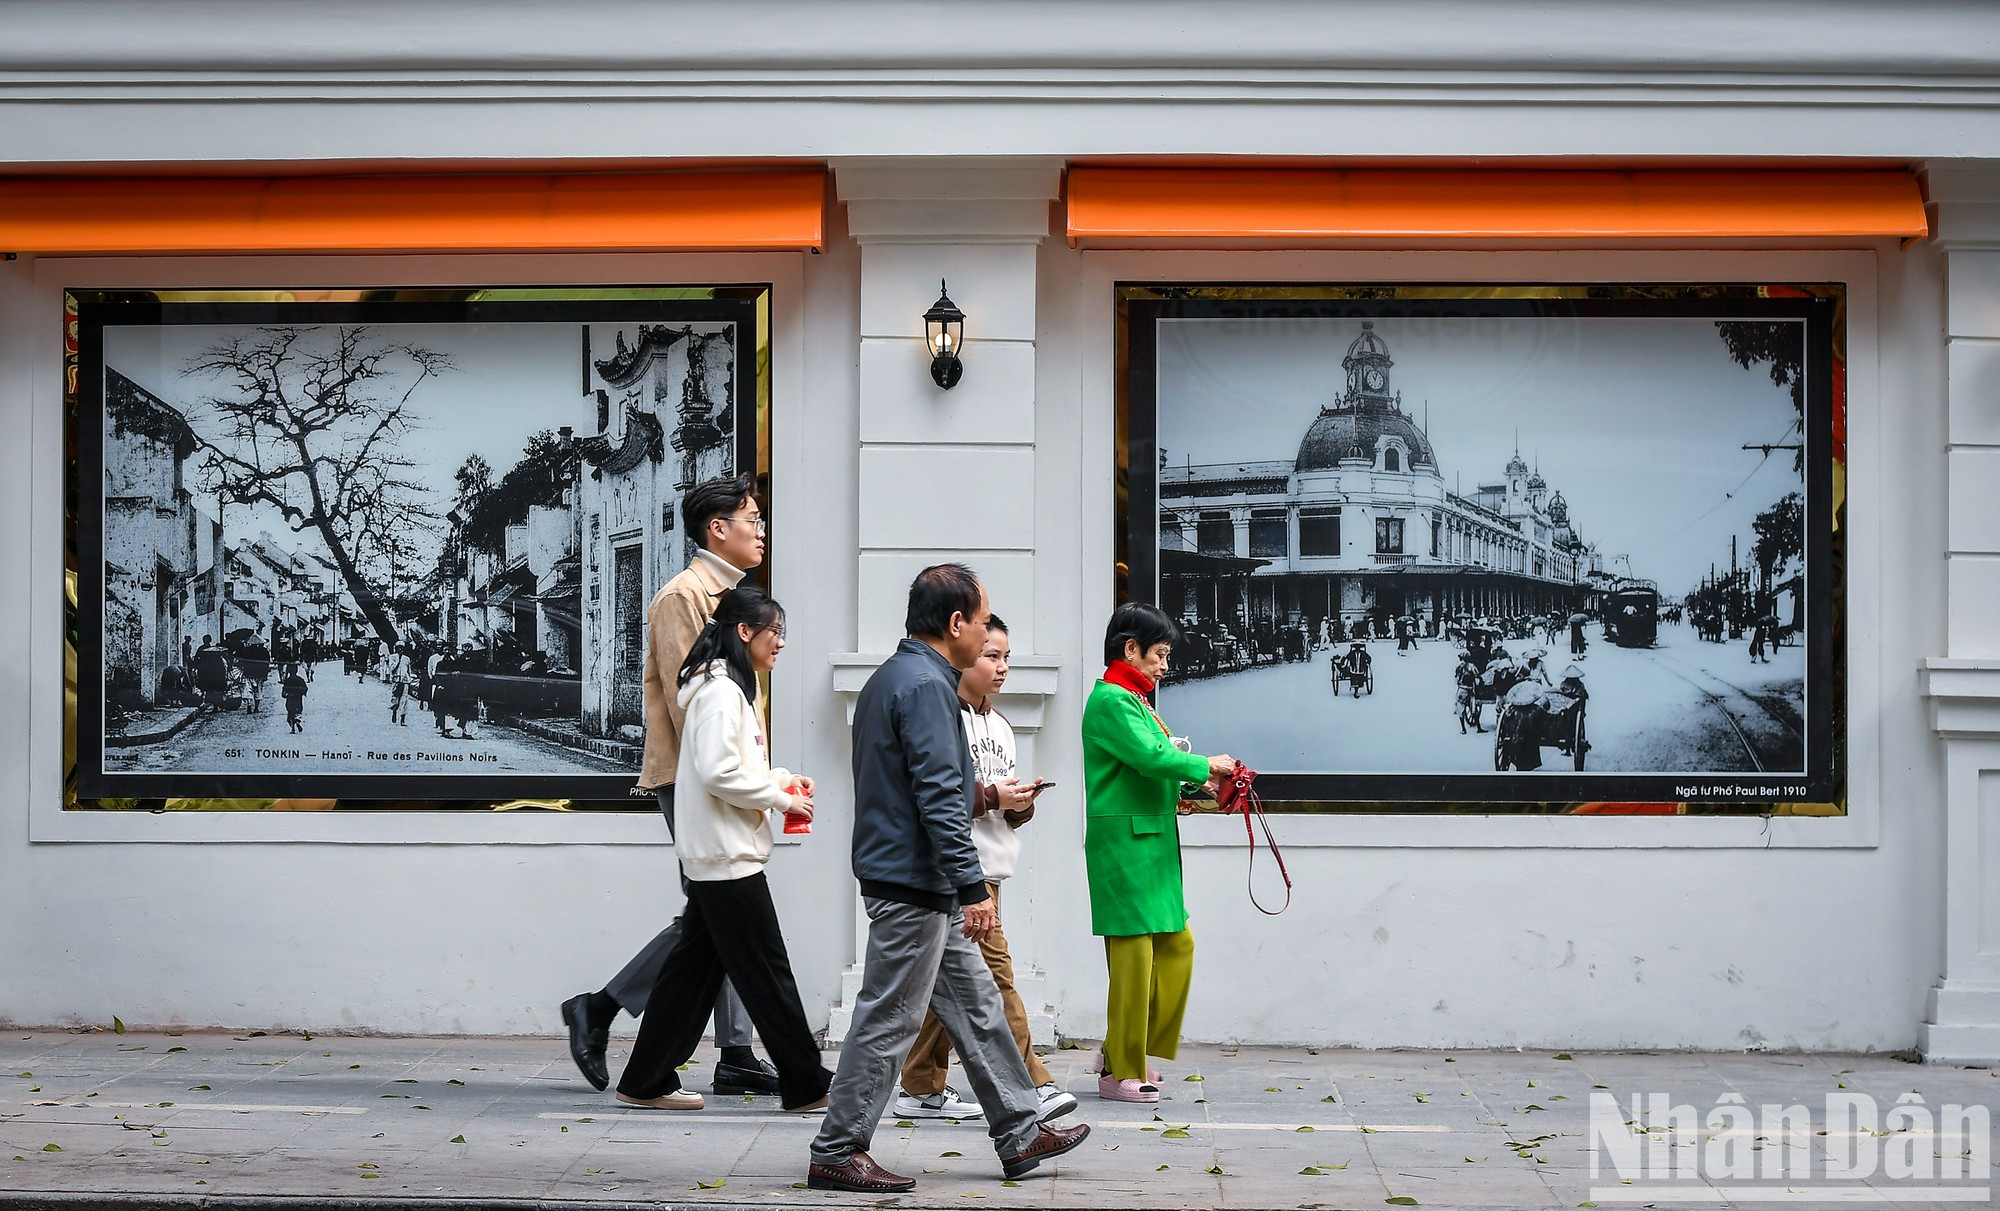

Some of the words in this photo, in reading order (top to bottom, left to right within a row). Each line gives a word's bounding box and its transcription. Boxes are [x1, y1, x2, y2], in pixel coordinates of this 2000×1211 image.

[255, 748, 300, 759] TONKIN
[367, 751, 388, 761] Rue
[392, 751, 412, 761] des
[416, 751, 464, 762] Pavillons
[469, 752, 498, 763] Noirs
[992, 768, 1008, 777] 1992
[1675, 785, 1698, 798] Ngã
[1700, 784, 1712, 796] tư
[1714, 782, 1734, 796] Phố
[1735, 785, 1758, 796] Paul
[1760, 785, 1780, 796] Bert
[1783, 785, 1807, 796] 1910
